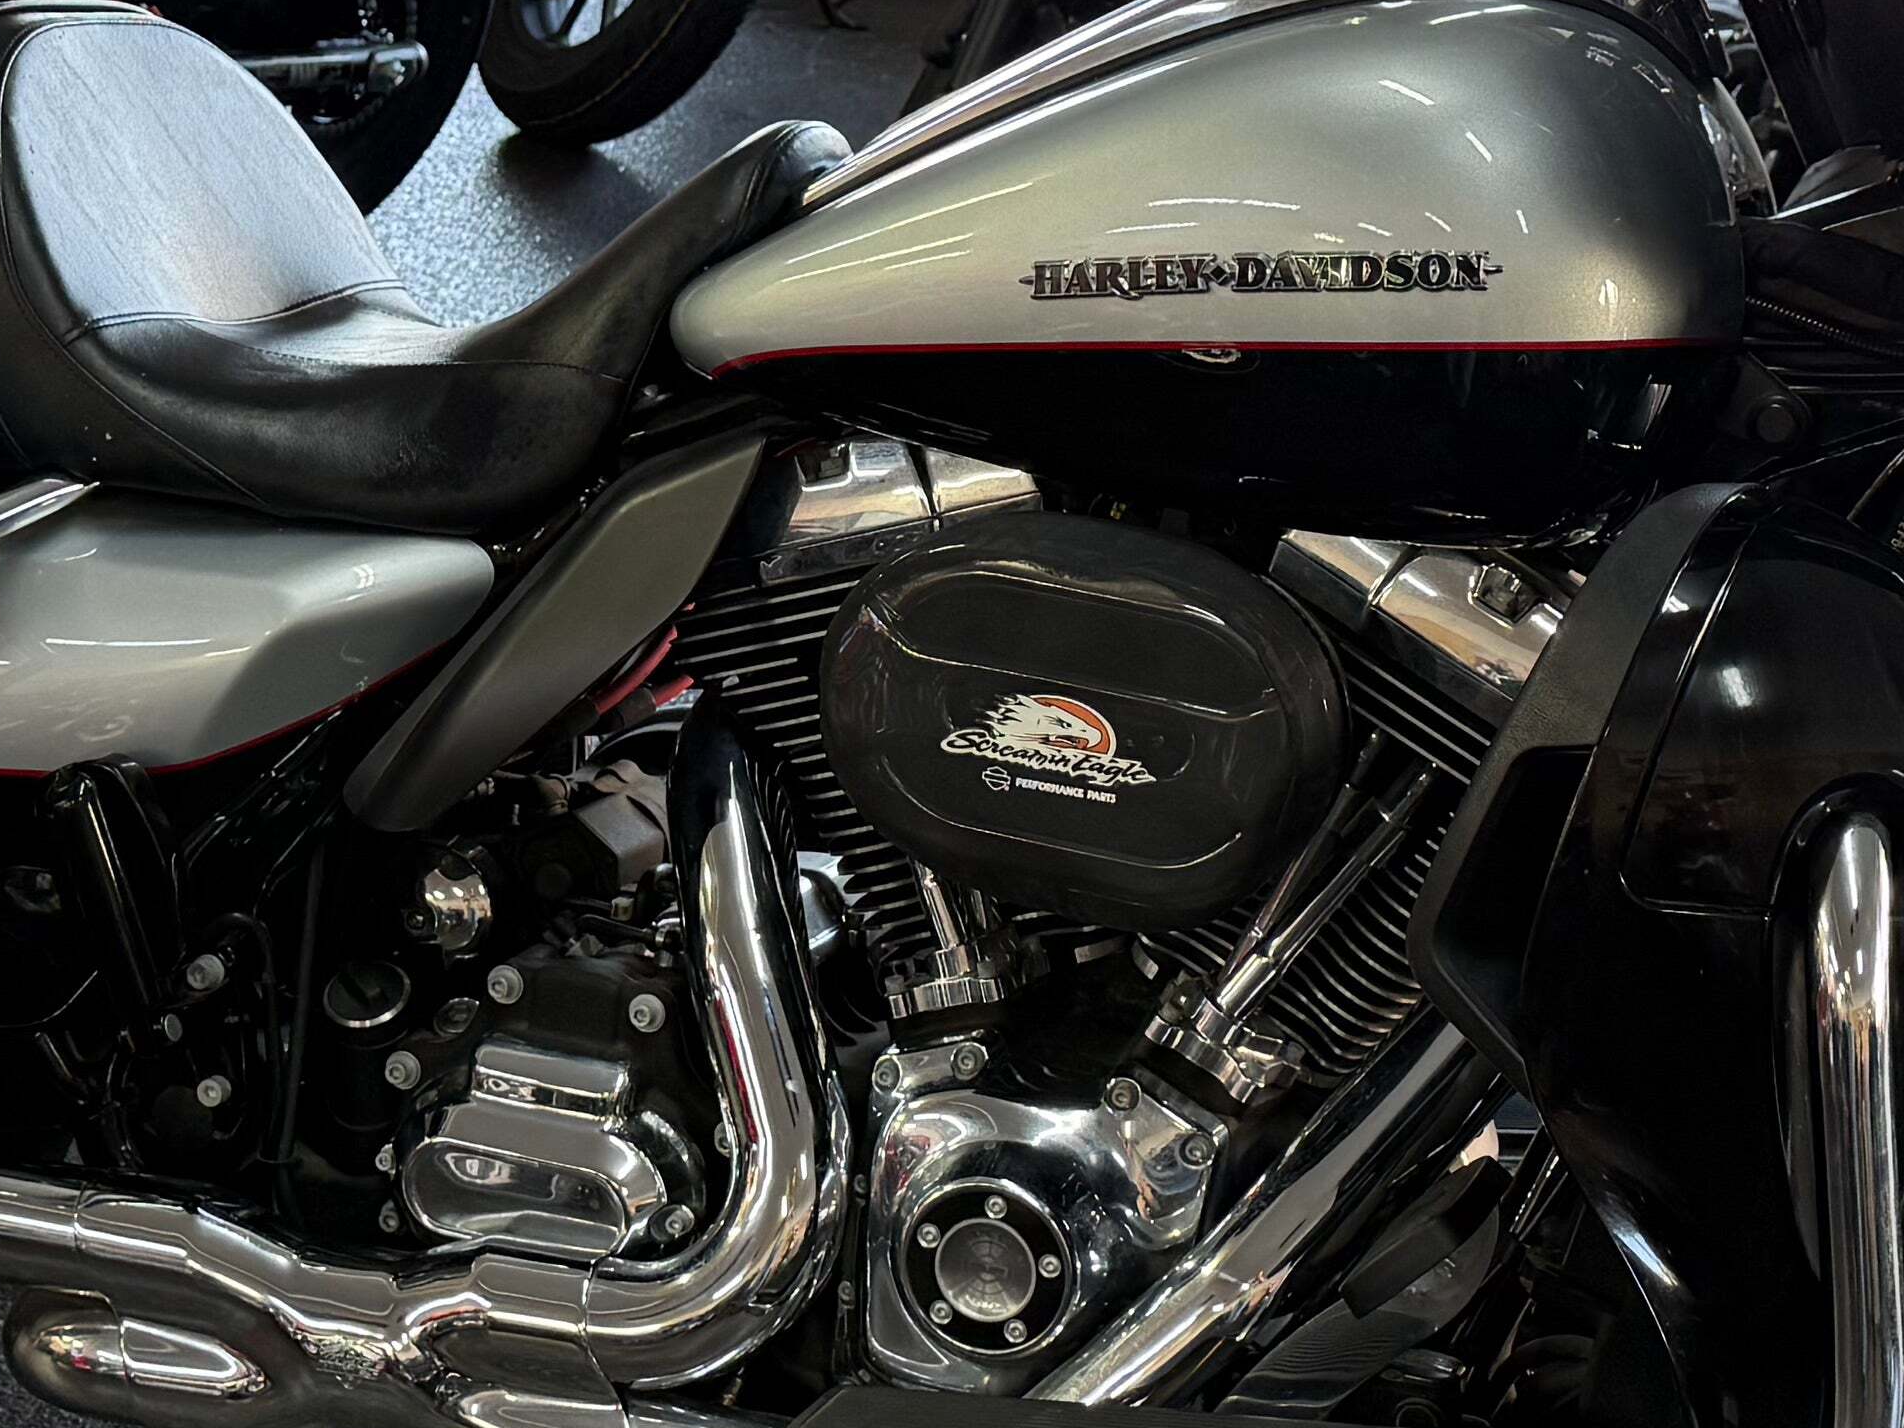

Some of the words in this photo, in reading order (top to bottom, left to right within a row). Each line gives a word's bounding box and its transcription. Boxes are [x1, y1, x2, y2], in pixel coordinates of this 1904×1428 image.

[1071, 754, 1149, 784] Eagle
[1015, 777, 1084, 800] PERFORMANCE
[1086, 790, 1117, 804] PARTS
